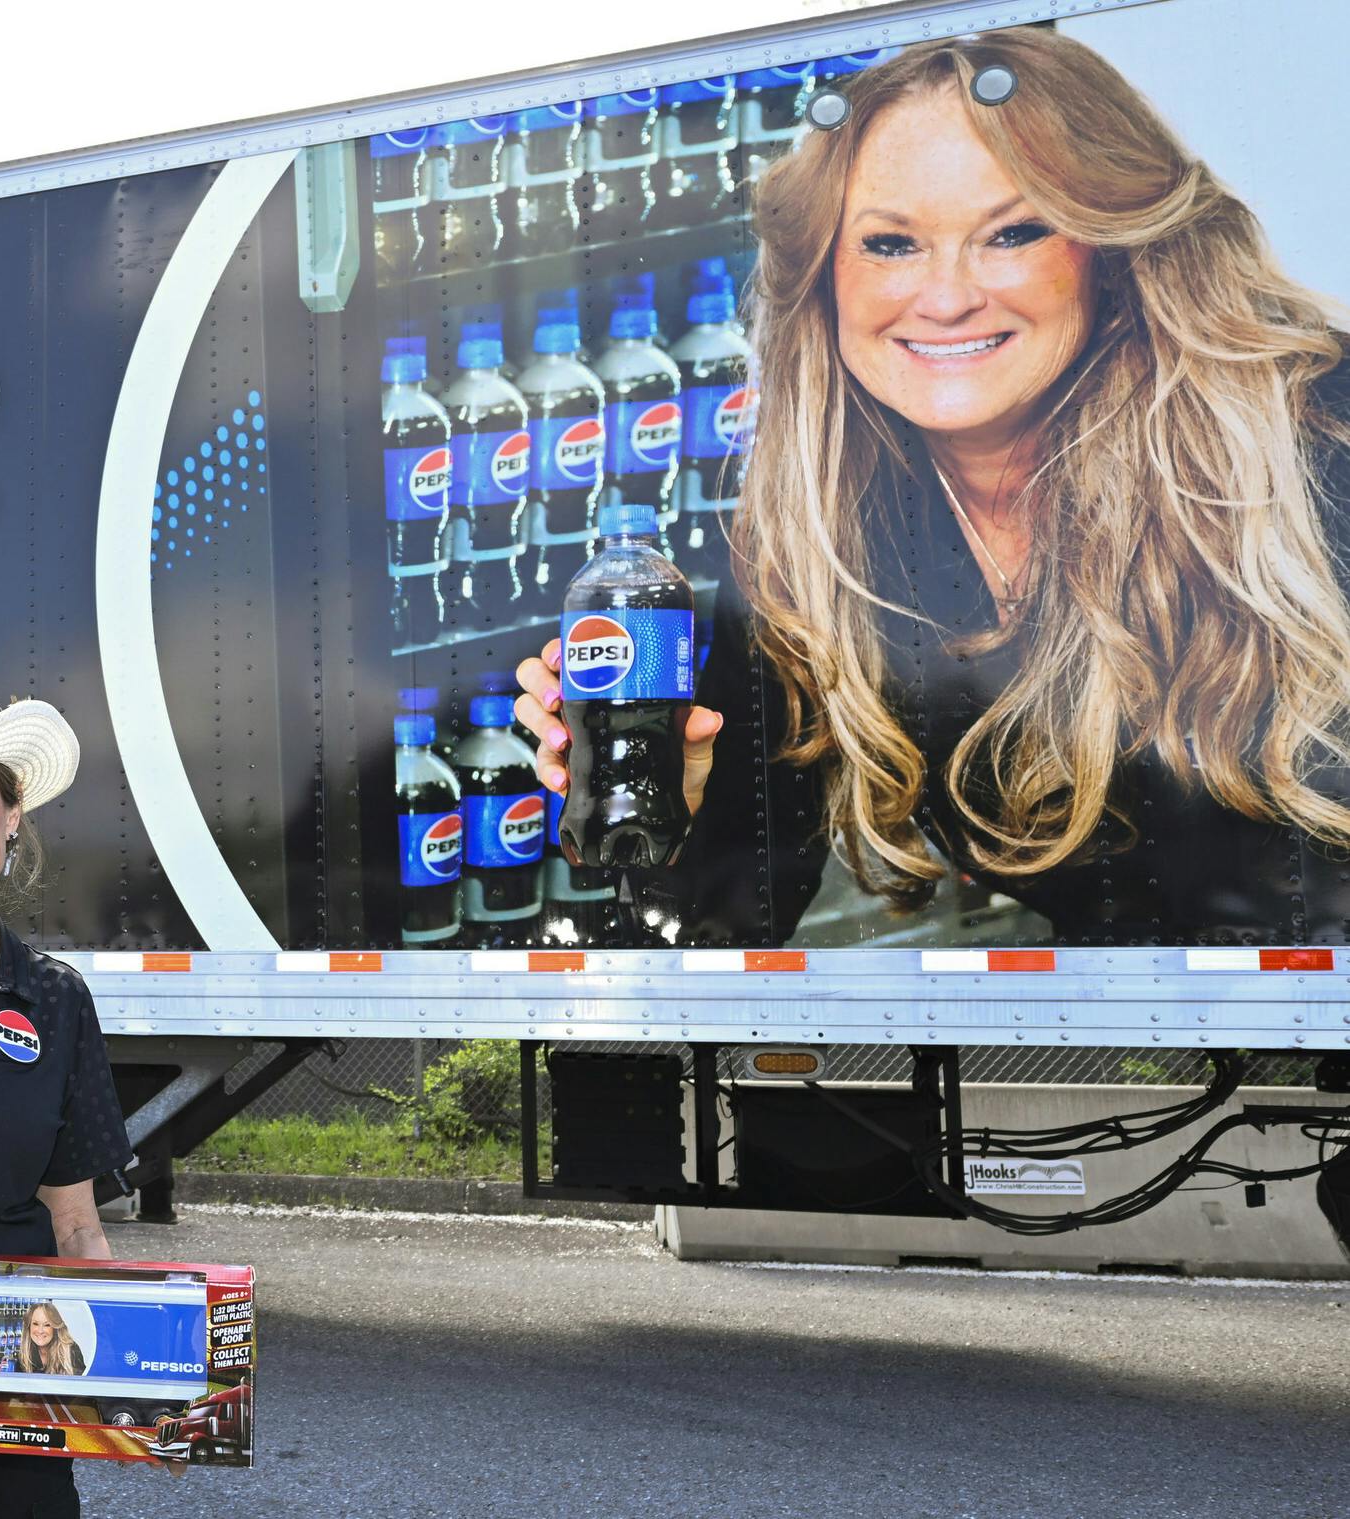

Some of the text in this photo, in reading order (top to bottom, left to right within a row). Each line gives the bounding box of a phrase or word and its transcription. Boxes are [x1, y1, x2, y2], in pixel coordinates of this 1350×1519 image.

[567, 645, 628, 661] PEPSI
[221, 1292, 239, 1300] AGES
[213, 1302, 252, 1315] 1:32 DIE-CAST
[213, 1310, 252, 1323] WITH PLASTIC
[213, 1324, 251, 1337] OPENABLE
[221, 1334, 244, 1344] DOOR
[213, 1347, 250, 1360] COLLECT
[140, 1361, 205, 1374] PEPSICO
[214, 1359, 233, 1368] THEM
[22, 1432, 50, 1443] T700
